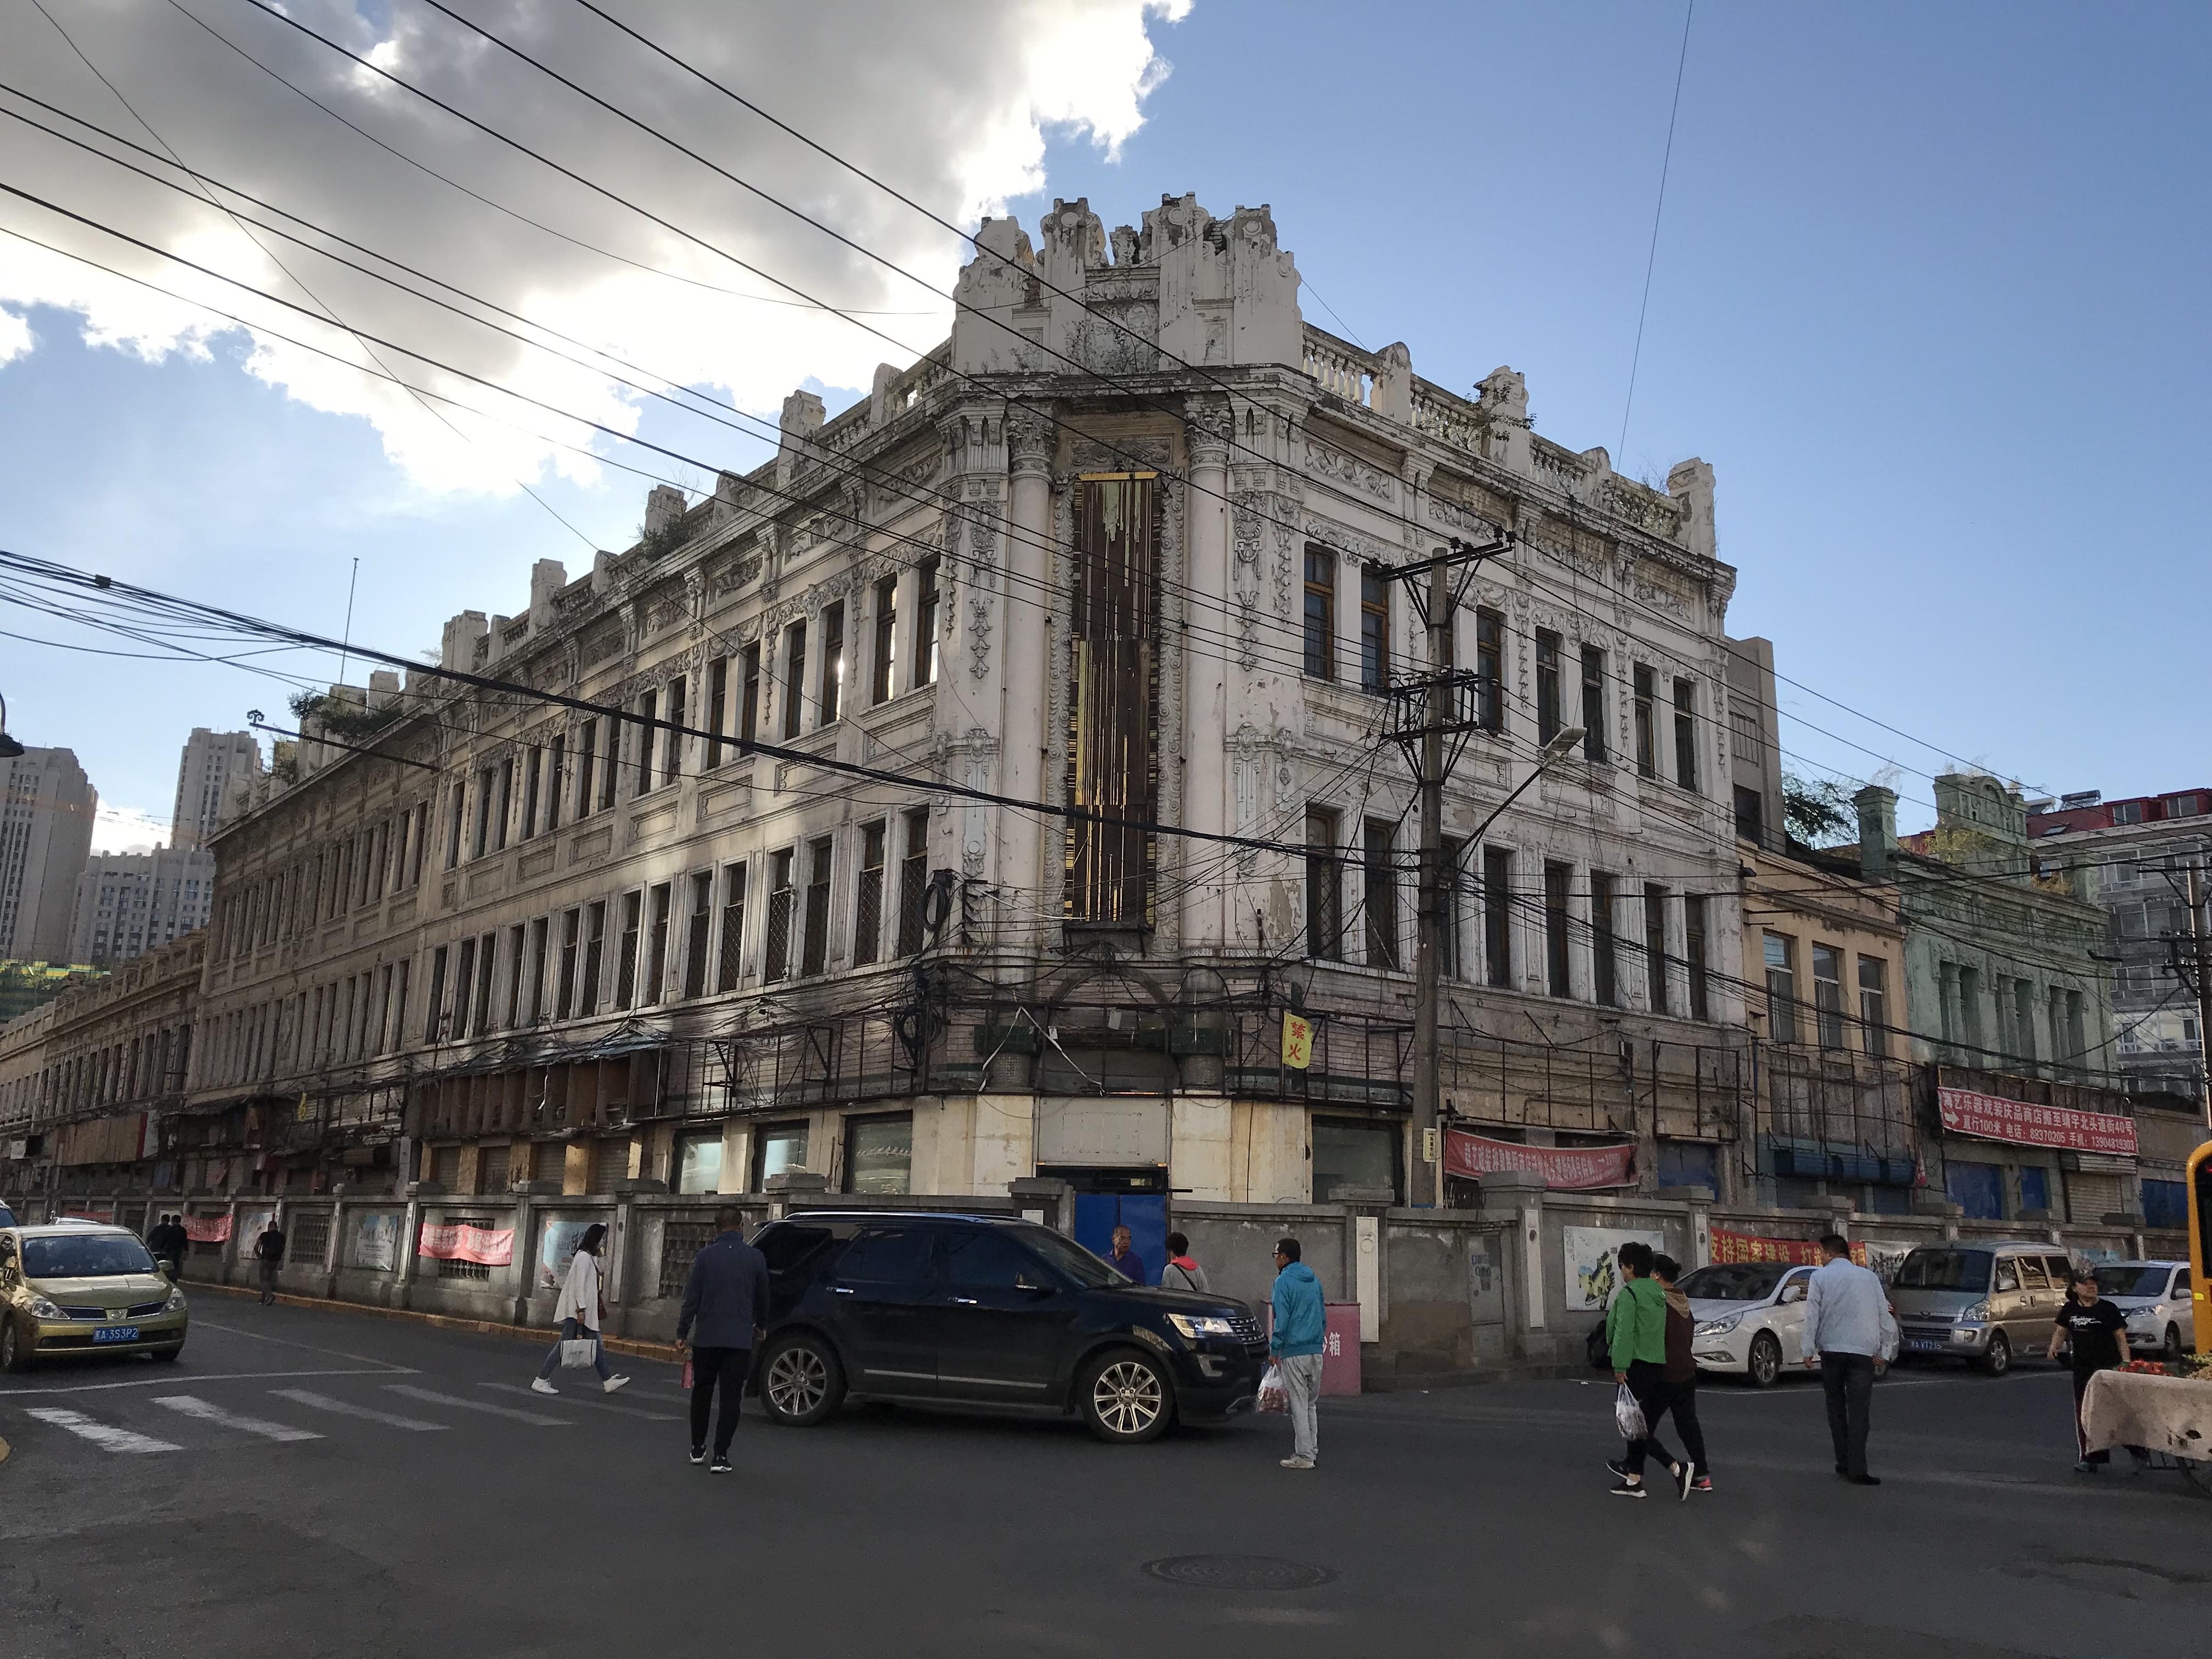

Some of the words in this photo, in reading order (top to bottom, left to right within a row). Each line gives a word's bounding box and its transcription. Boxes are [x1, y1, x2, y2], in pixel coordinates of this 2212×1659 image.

[1288, 1021, 1306, 1060] 禁火
[1963, 1114, 2001, 1135] 直行100米
